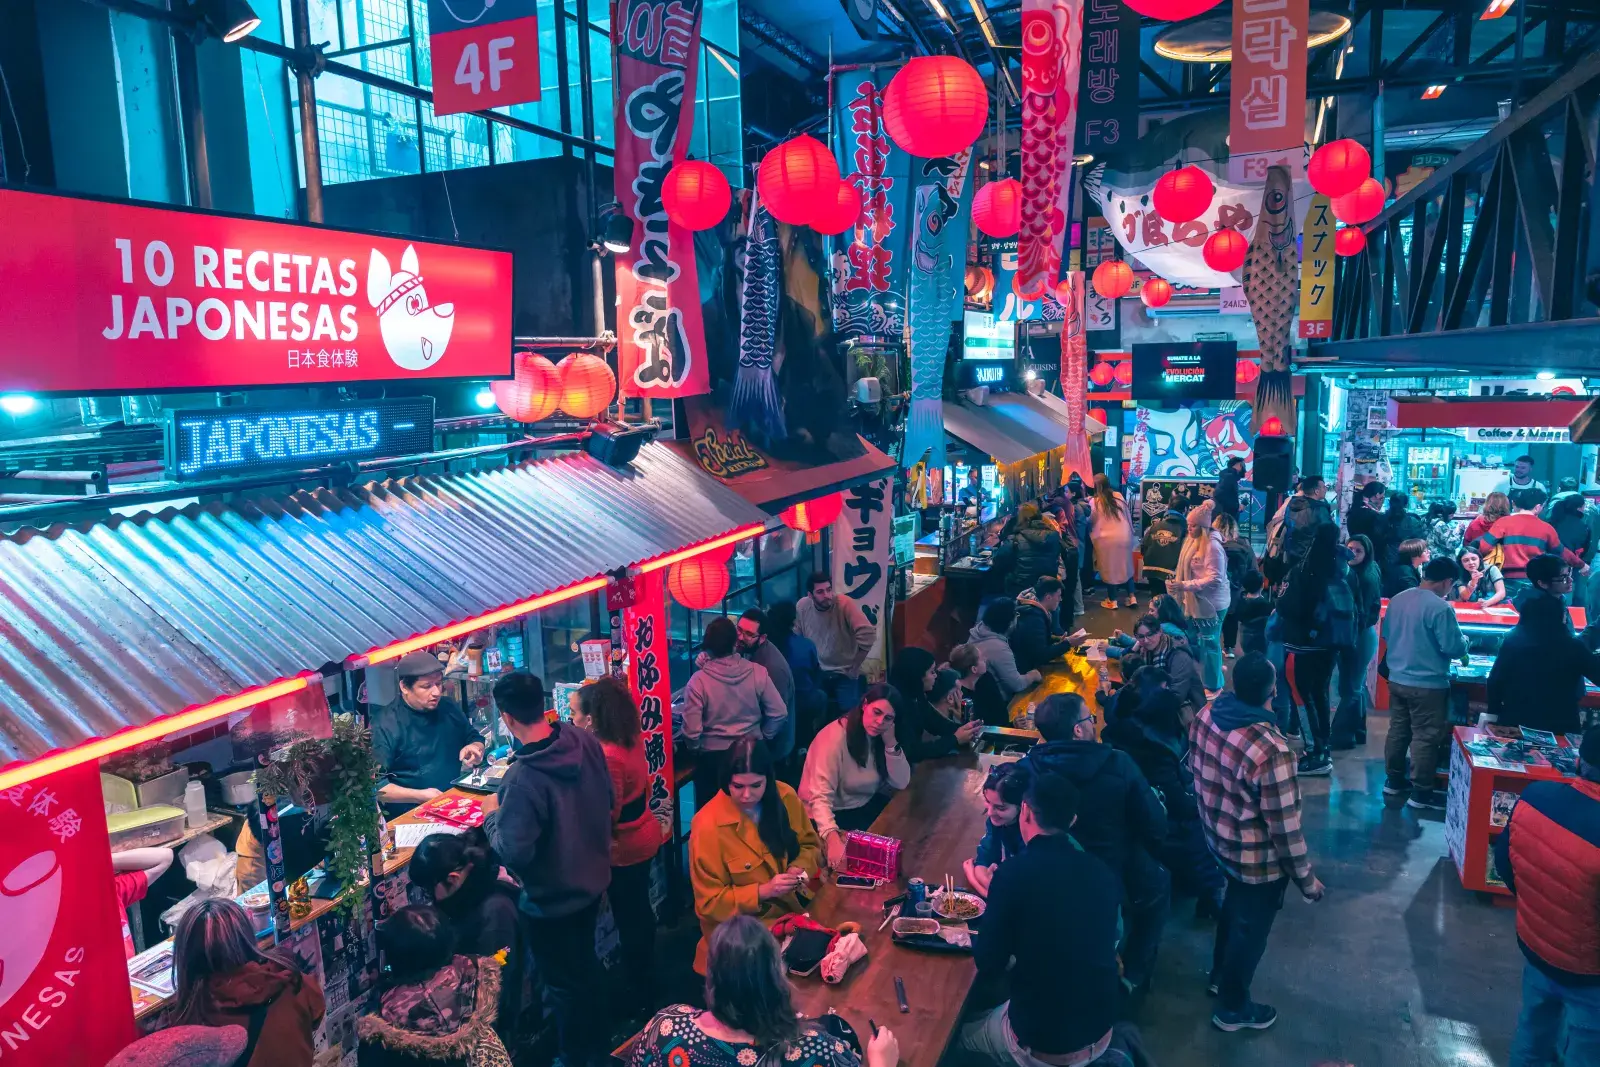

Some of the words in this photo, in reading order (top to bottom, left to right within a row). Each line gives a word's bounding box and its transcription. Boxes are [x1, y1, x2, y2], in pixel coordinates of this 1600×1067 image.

[454, 36, 515, 95] 4F
[1088, 0, 1120, 104] 노래방
[1085, 118, 1120, 146] F3
[116, 239, 175, 287] 10
[194, 246, 359, 297] RECETAS
[1310, 205, 1329, 305] スナック
[102, 295, 360, 342] JAPONESAS
[1306, 323, 1325, 335] 3F
[287, 348, 359, 369] 日本食体験
[1166, 374, 1205, 382] MERCAT
[180, 406, 381, 474] JAPONESAS
[1478, 428, 1514, 438] Coffee
[1517, 428, 1525, 438] &
[0, 946, 85, 1056] NESAS
